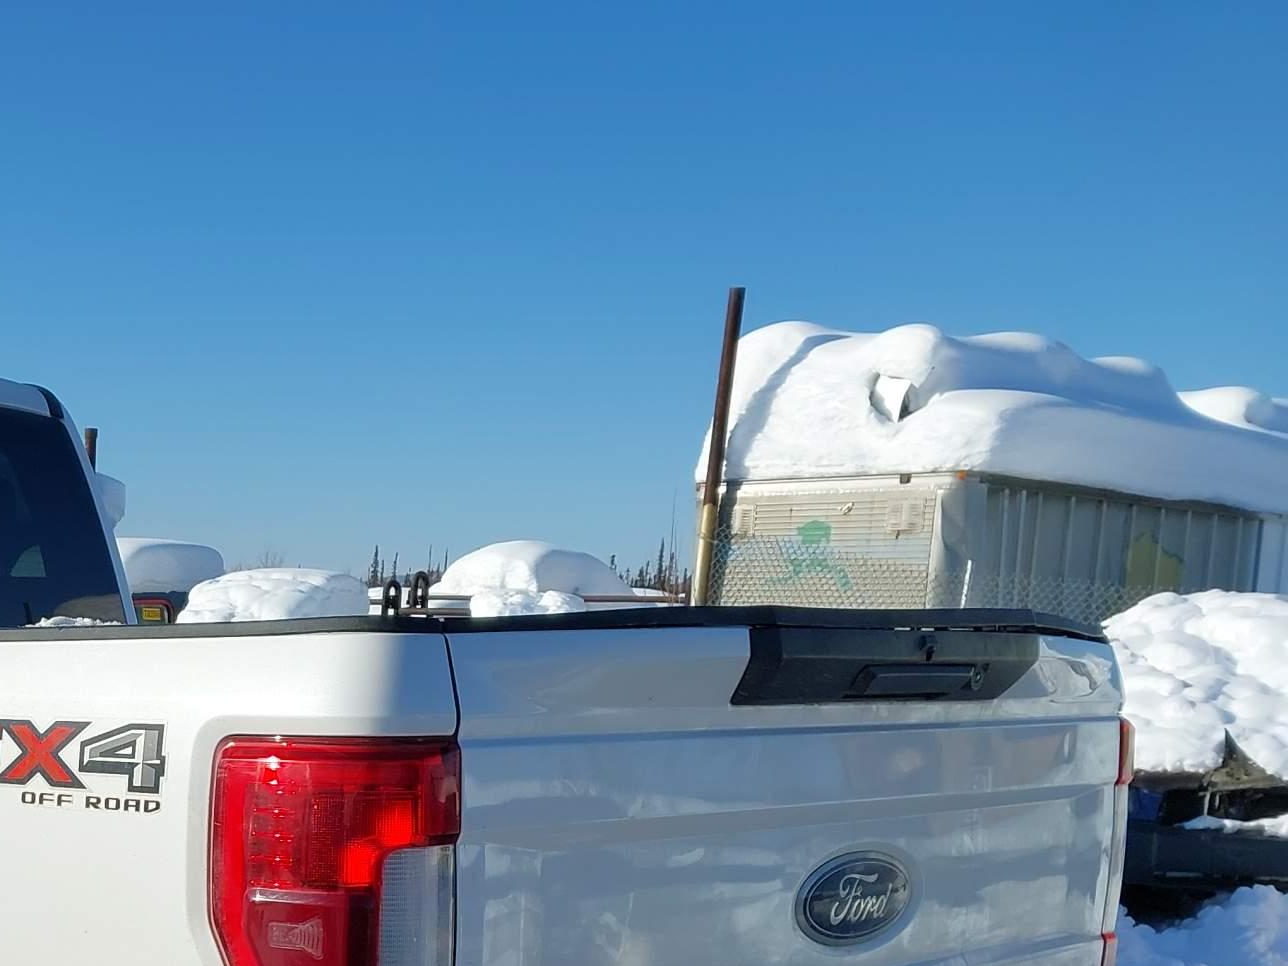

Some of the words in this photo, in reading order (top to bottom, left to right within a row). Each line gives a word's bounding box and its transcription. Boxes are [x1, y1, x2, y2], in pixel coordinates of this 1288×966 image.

[20, 791, 74, 807] OFF
[85, 795, 161, 814] ROAD
[830, 873, 893, 925] Ford
